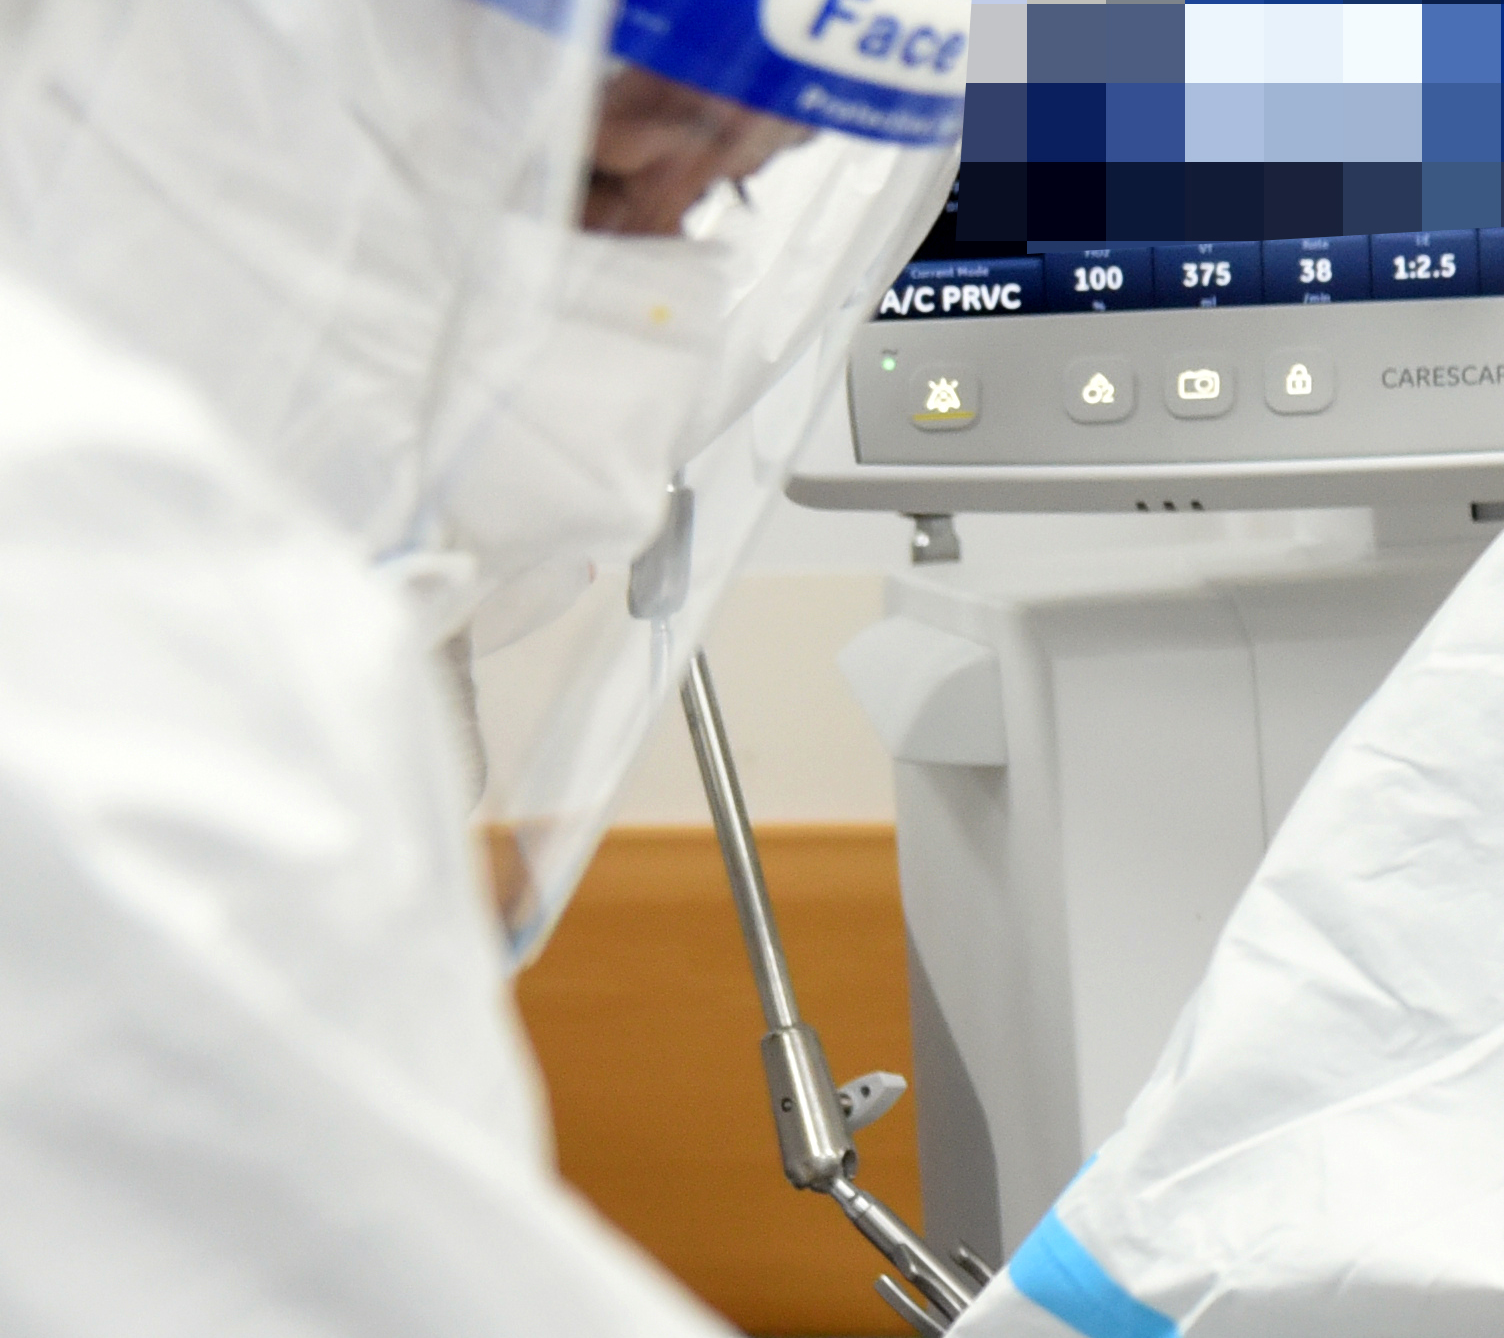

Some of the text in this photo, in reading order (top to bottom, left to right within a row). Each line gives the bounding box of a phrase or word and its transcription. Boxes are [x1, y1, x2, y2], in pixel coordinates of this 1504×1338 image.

[1074, 266, 1124, 292] 100
[1182, 261, 1232, 288] 375
[1299, 258, 1333, 283] 38
[1393, 253, 1456, 280] 1:2.5
[879, 282, 1023, 315] A/C PRVC
